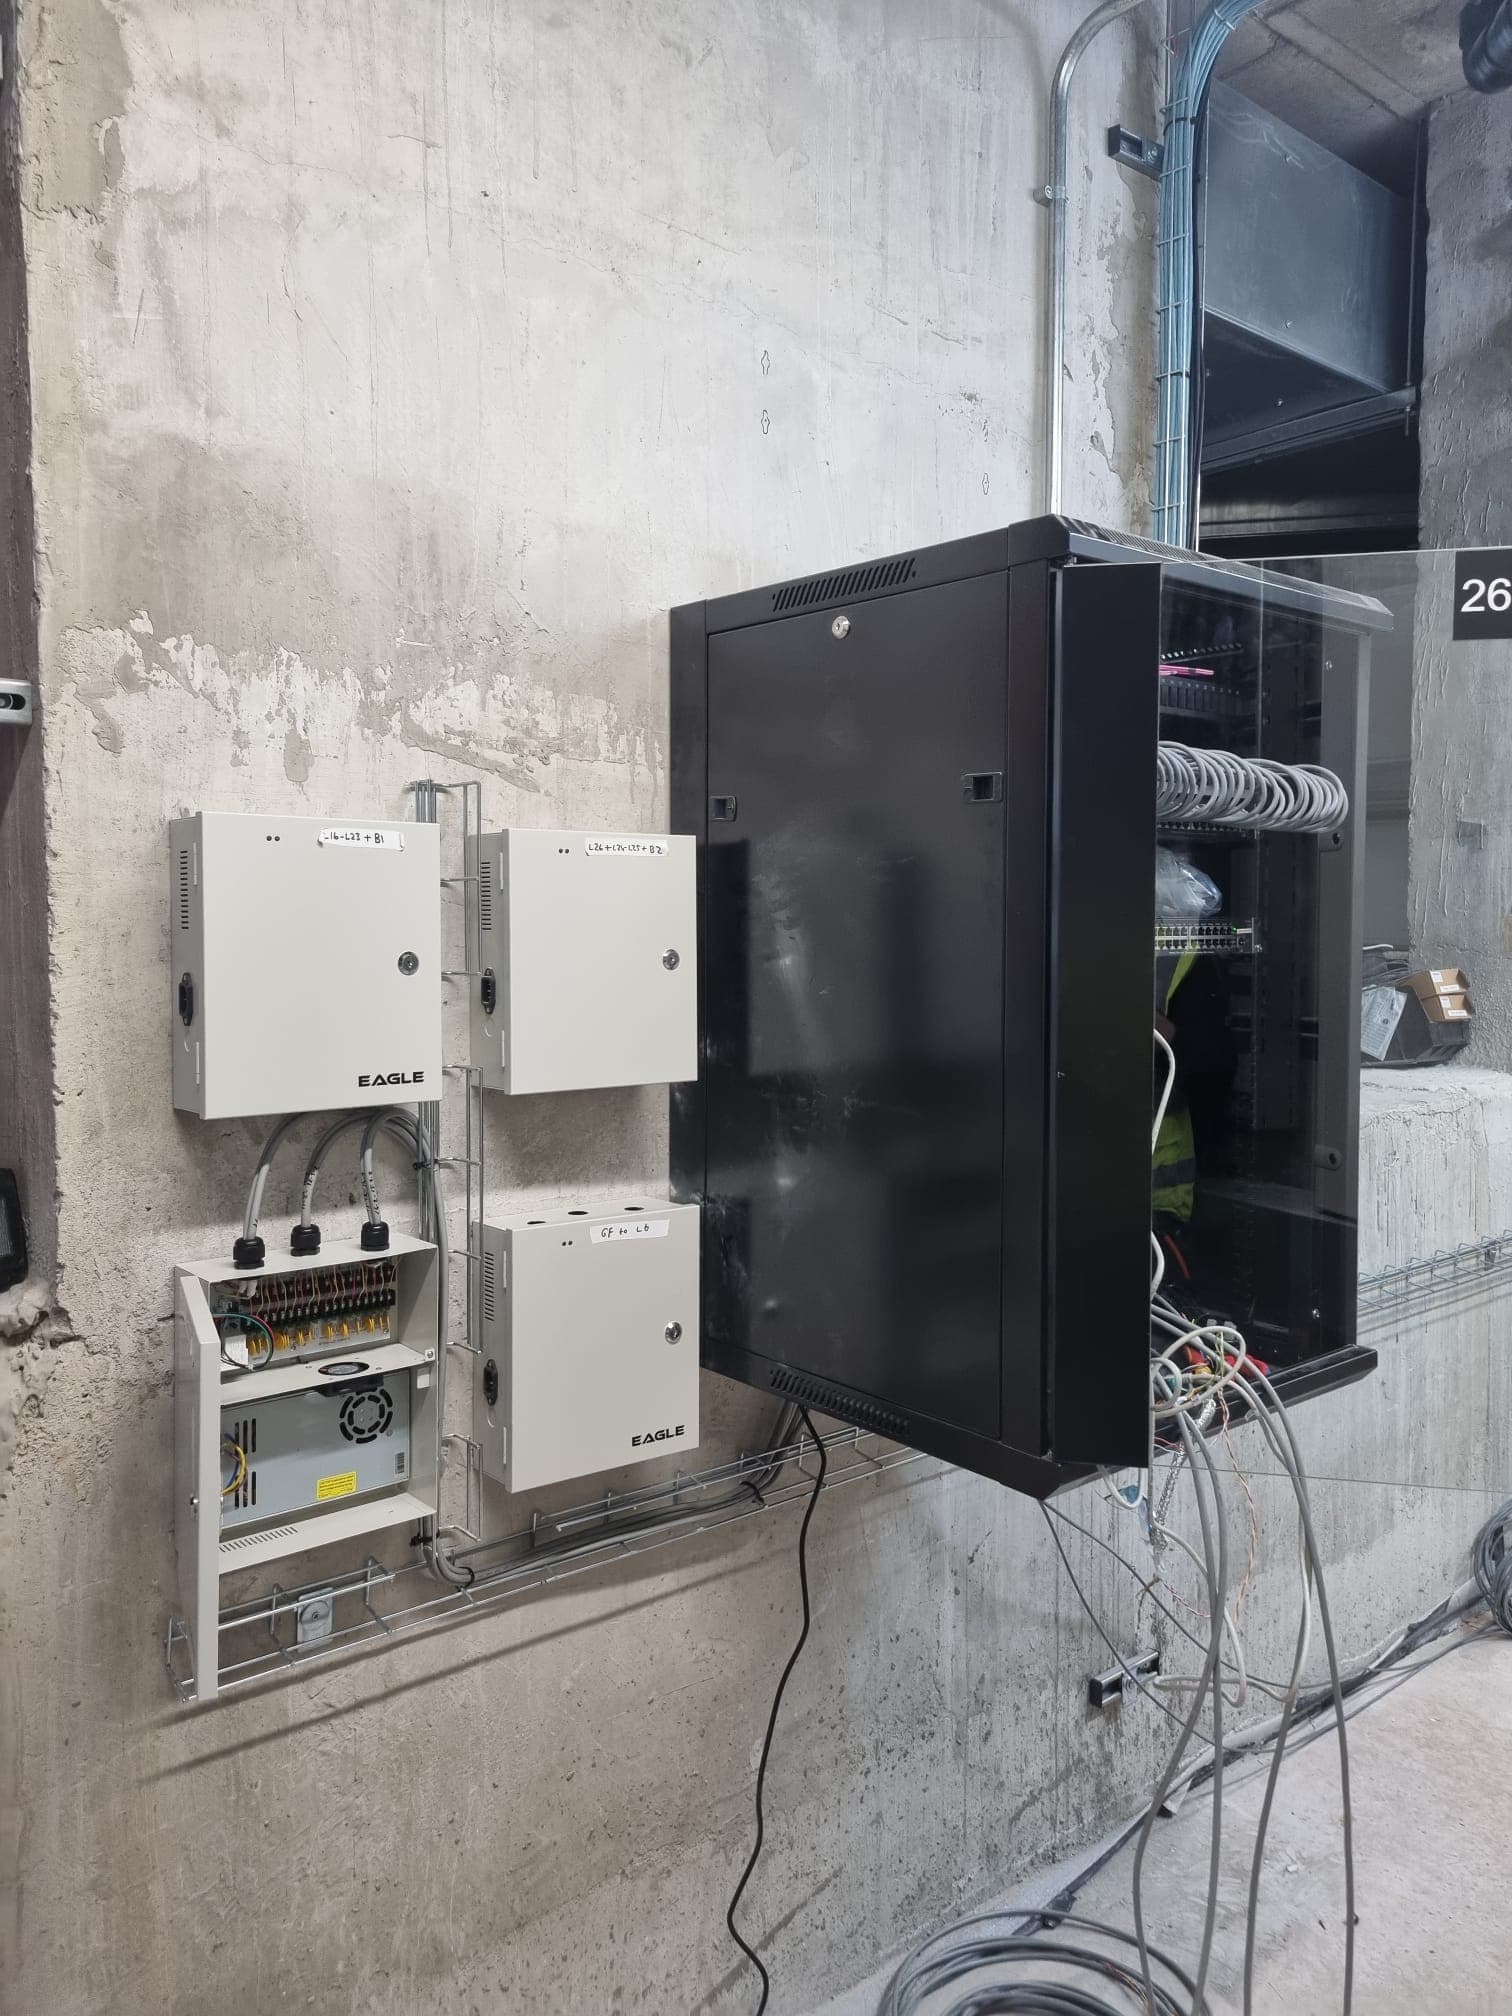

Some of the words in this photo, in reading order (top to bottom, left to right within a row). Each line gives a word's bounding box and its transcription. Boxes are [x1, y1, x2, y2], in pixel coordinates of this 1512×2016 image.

[1461, 578, 1512, 612] 26
[358, 1071, 425, 1088] EAGLE
[619, 1227, 628, 1236] to
[631, 1424, 686, 1447] EAGLE
